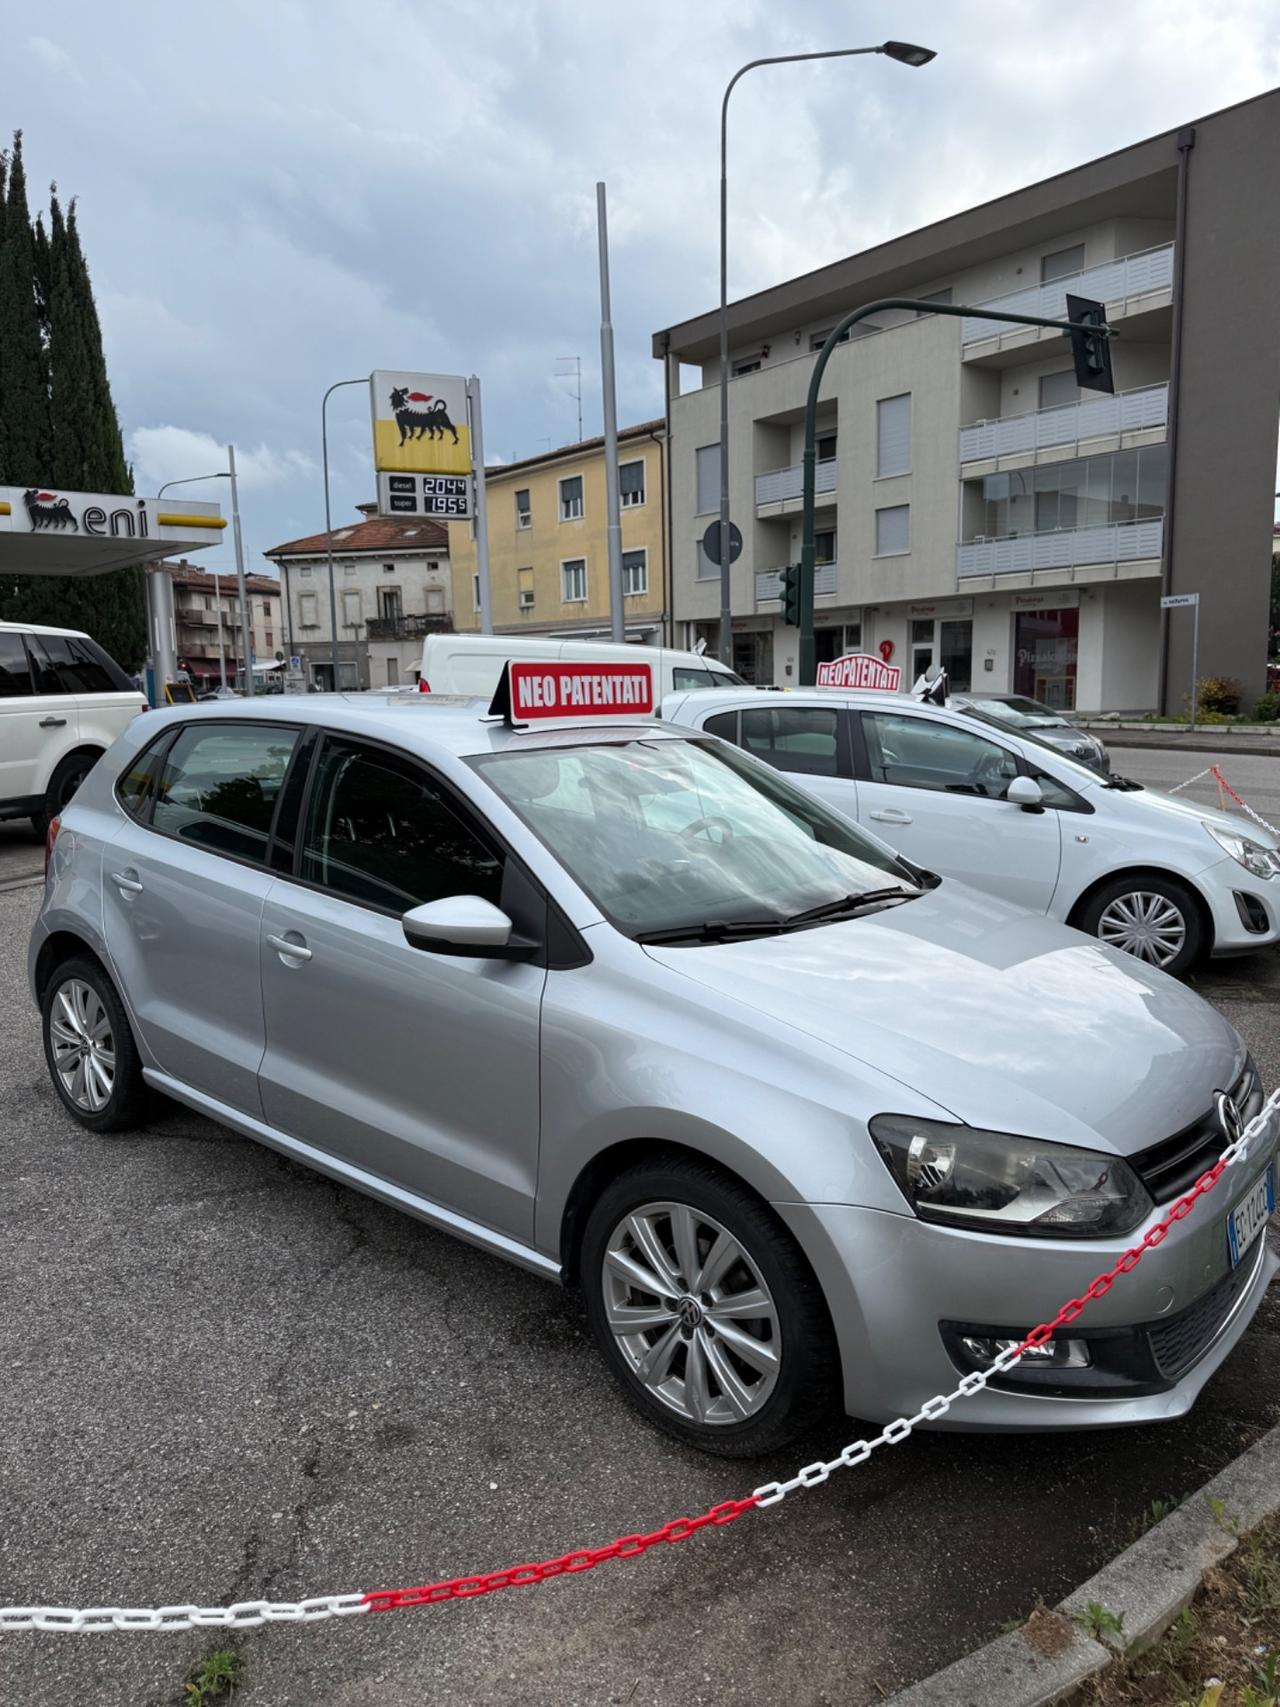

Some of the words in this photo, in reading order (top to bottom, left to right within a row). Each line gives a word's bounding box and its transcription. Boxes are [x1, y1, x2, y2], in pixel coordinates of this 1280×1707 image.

[83, 499, 149, 538] eni
[819, 658, 898, 689] NEOPATENTATI
[518, 675, 556, 708] NEO
[559, 675, 648, 706] PATENTATI
